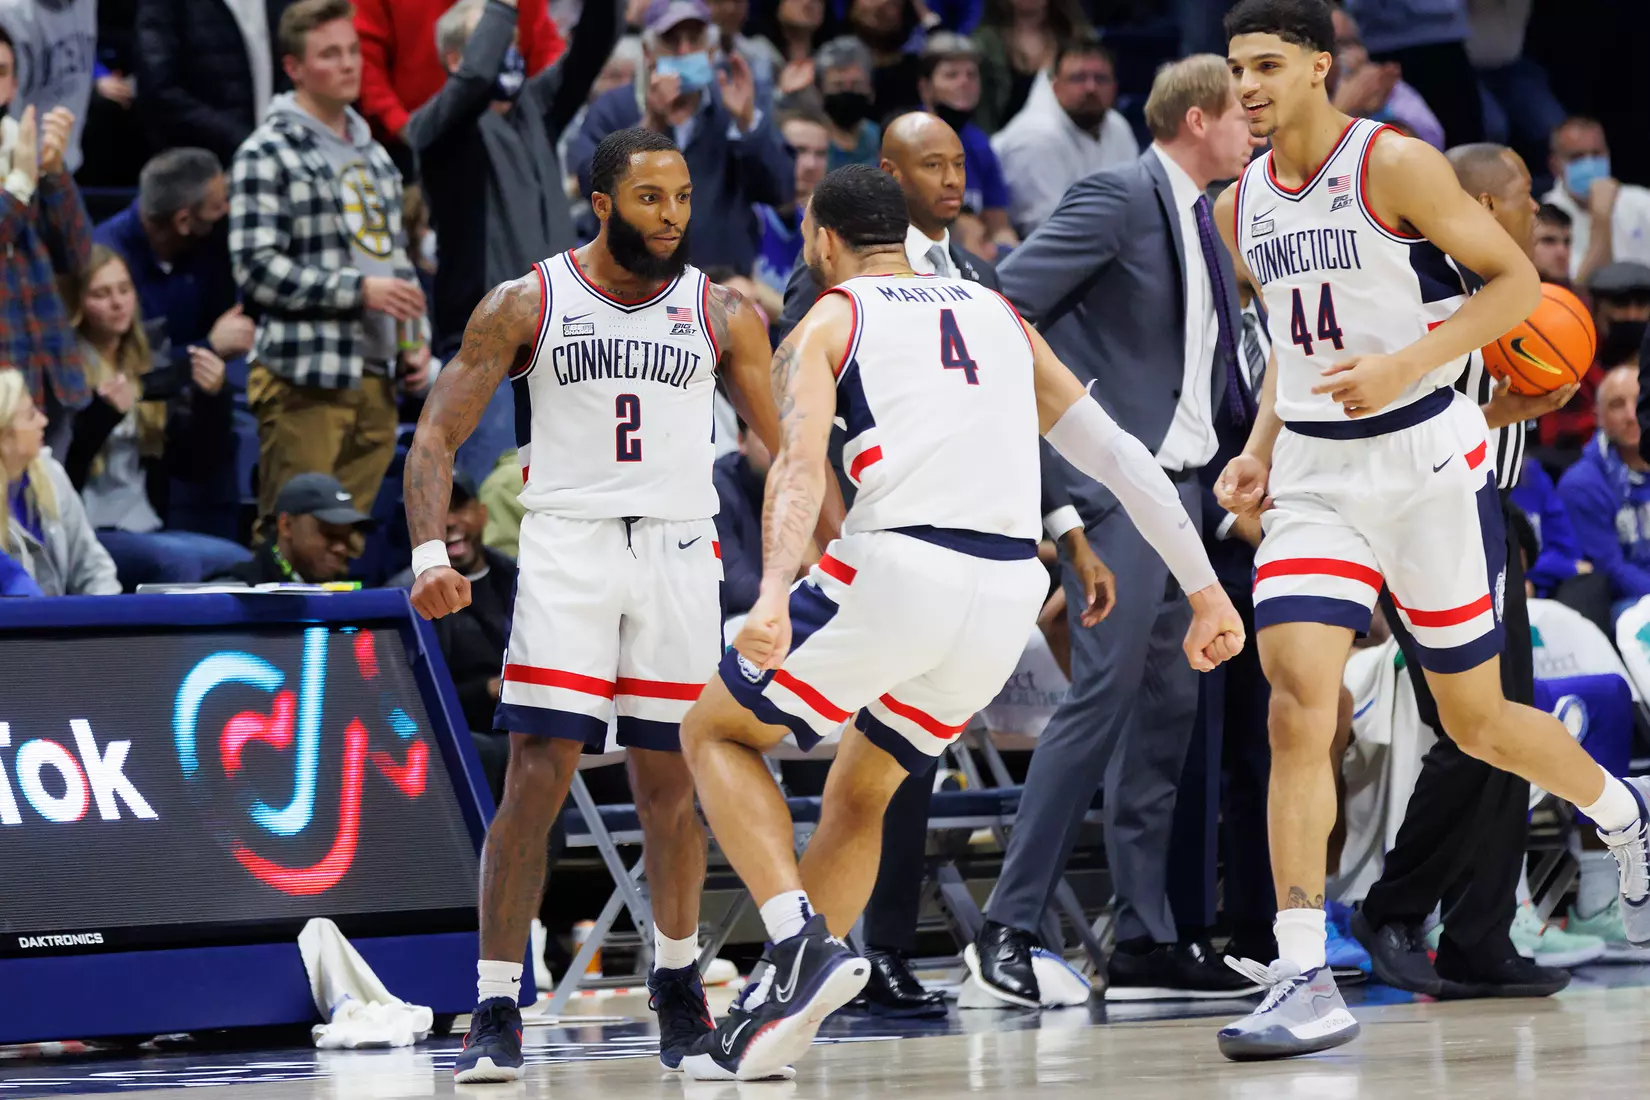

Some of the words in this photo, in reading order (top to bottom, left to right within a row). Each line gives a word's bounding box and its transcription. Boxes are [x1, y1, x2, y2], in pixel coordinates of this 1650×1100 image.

[1246, 228, 1361, 286] CONNECTICUT
[876, 285, 973, 302] MARTIN
[1291, 282, 1344, 356] 44
[552, 338, 701, 390] CONNECTICUT
[940, 308, 980, 385] 4
[615, 393, 642, 462] 2
[18, 932, 104, 949] DAKTRONICS
